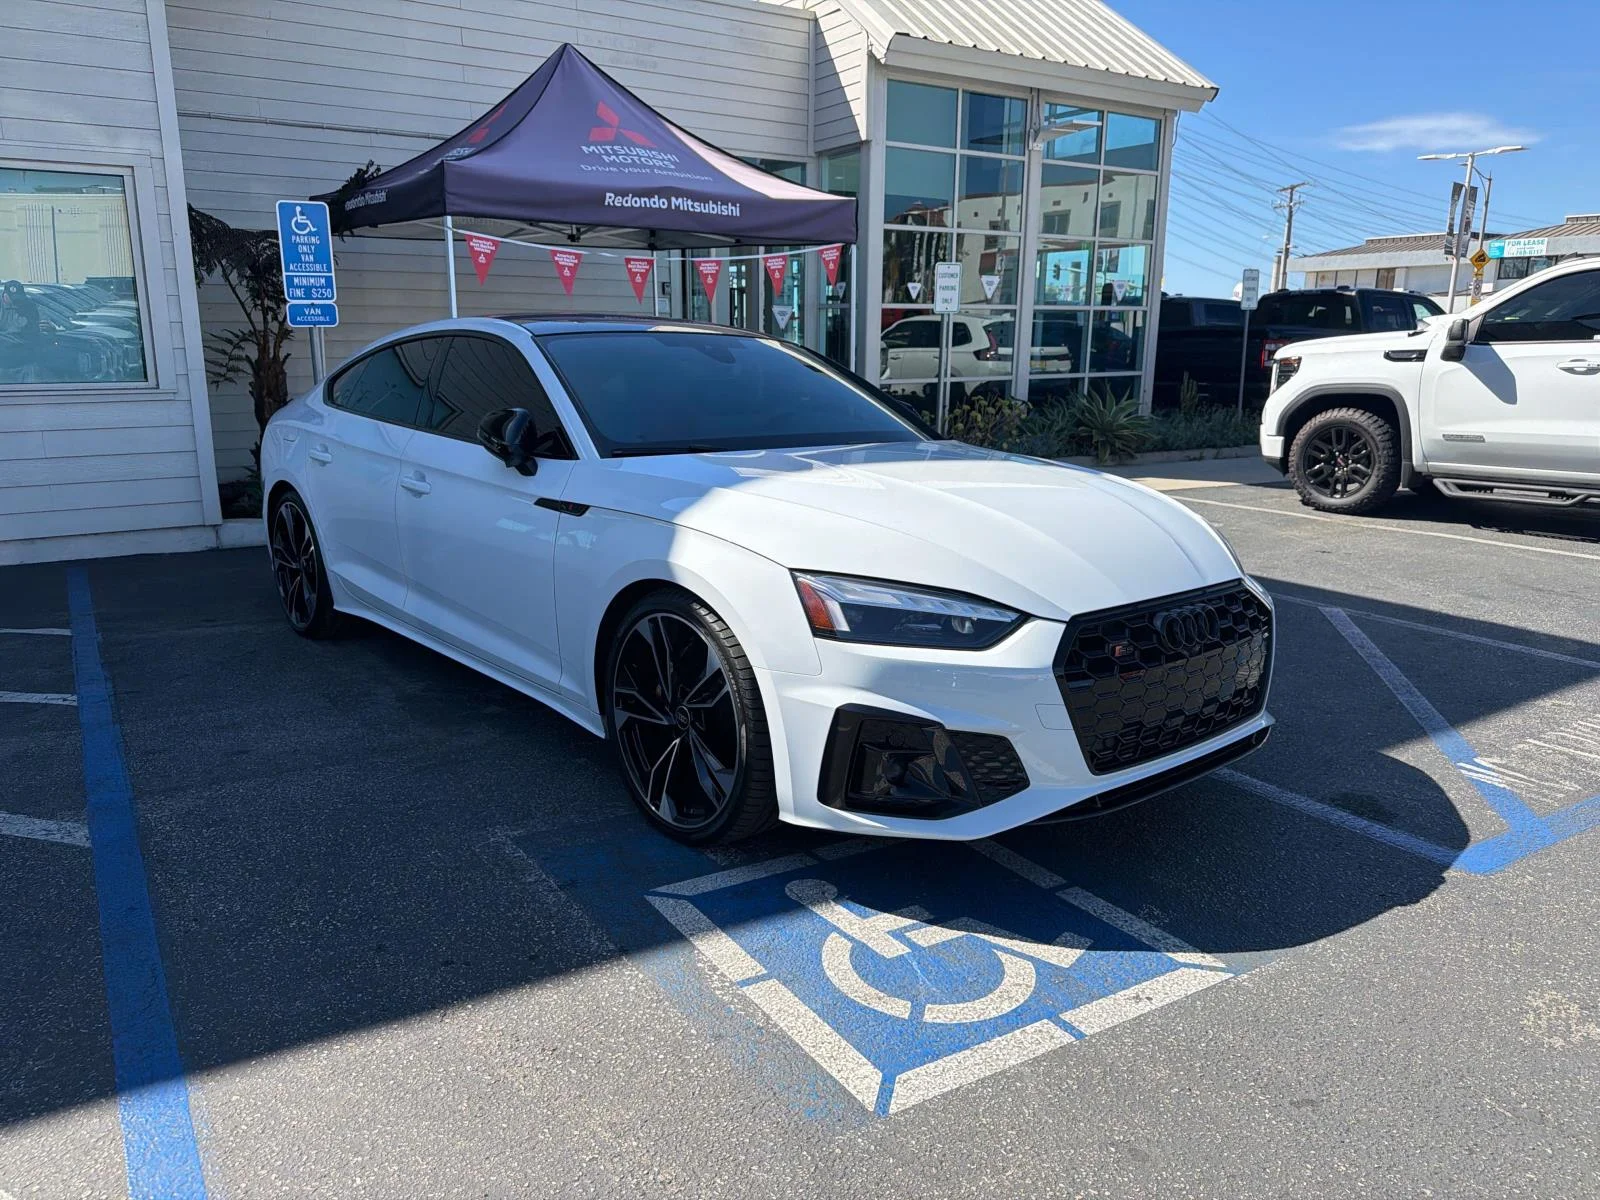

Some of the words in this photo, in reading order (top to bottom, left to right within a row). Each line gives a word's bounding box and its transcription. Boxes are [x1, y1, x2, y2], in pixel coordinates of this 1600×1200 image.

[581, 145, 679, 163] MITSUBISHI
[601, 155, 676, 169] MOTORS
[604, 192, 669, 209] Redondo
[671, 196, 741, 217] Mitsubishi
[291, 235, 320, 244] PARKING
[297, 244, 315, 254] ONLY
[300, 254, 314, 262] VAN
[289, 263, 328, 272] ACCESSIBLE
[293, 277, 326, 287] MINIMUM
[289, 288, 306, 298] FINE
[311, 288, 332, 298] $250
[303, 307, 321, 315] VAN
